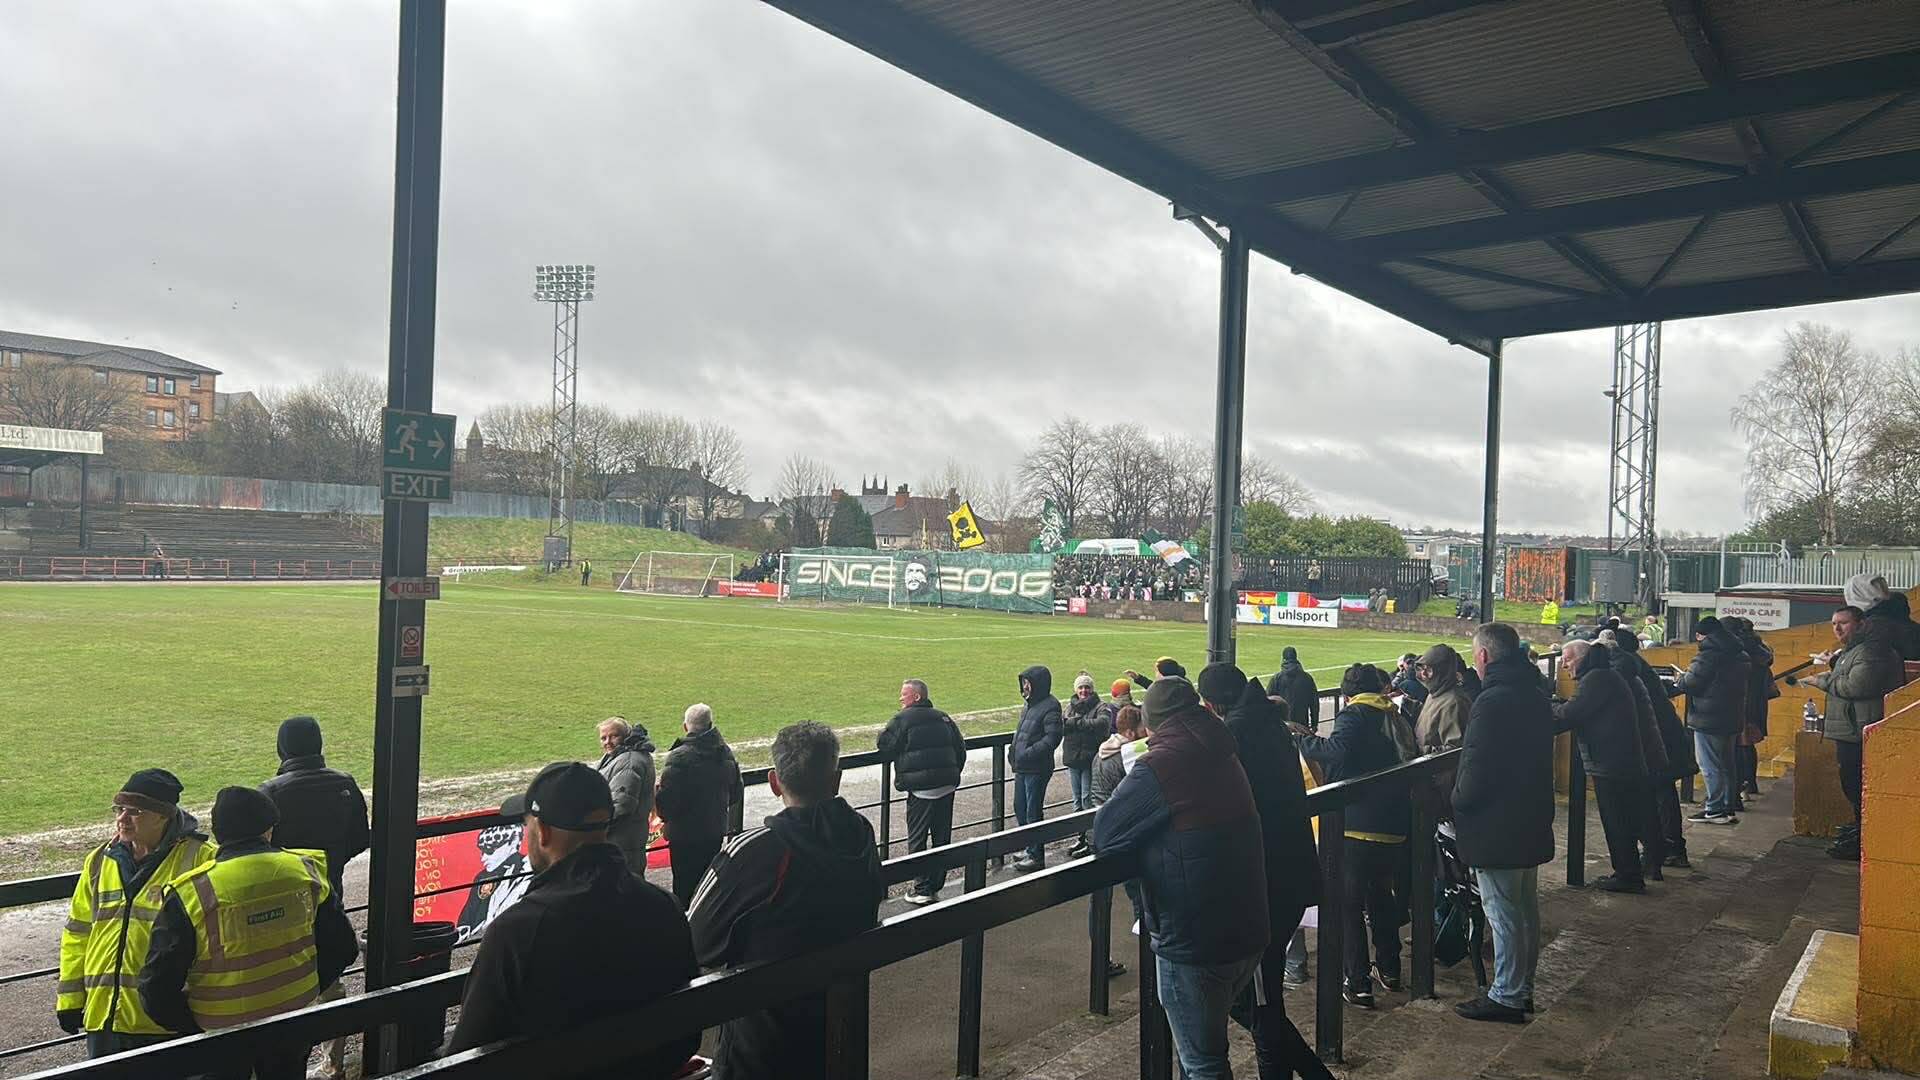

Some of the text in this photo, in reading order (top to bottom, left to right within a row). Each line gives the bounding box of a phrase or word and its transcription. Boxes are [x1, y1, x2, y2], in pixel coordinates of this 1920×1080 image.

[1, 426, 28, 439] Ltd.
[391, 472, 444, 497] EXIT
[797, 561, 1051, 596] SINCE 2006
[400, 582, 437, 594] TOILET
[1278, 609, 1329, 622] uhlsport
[1721, 607, 1782, 617] SHOP & CAFE
